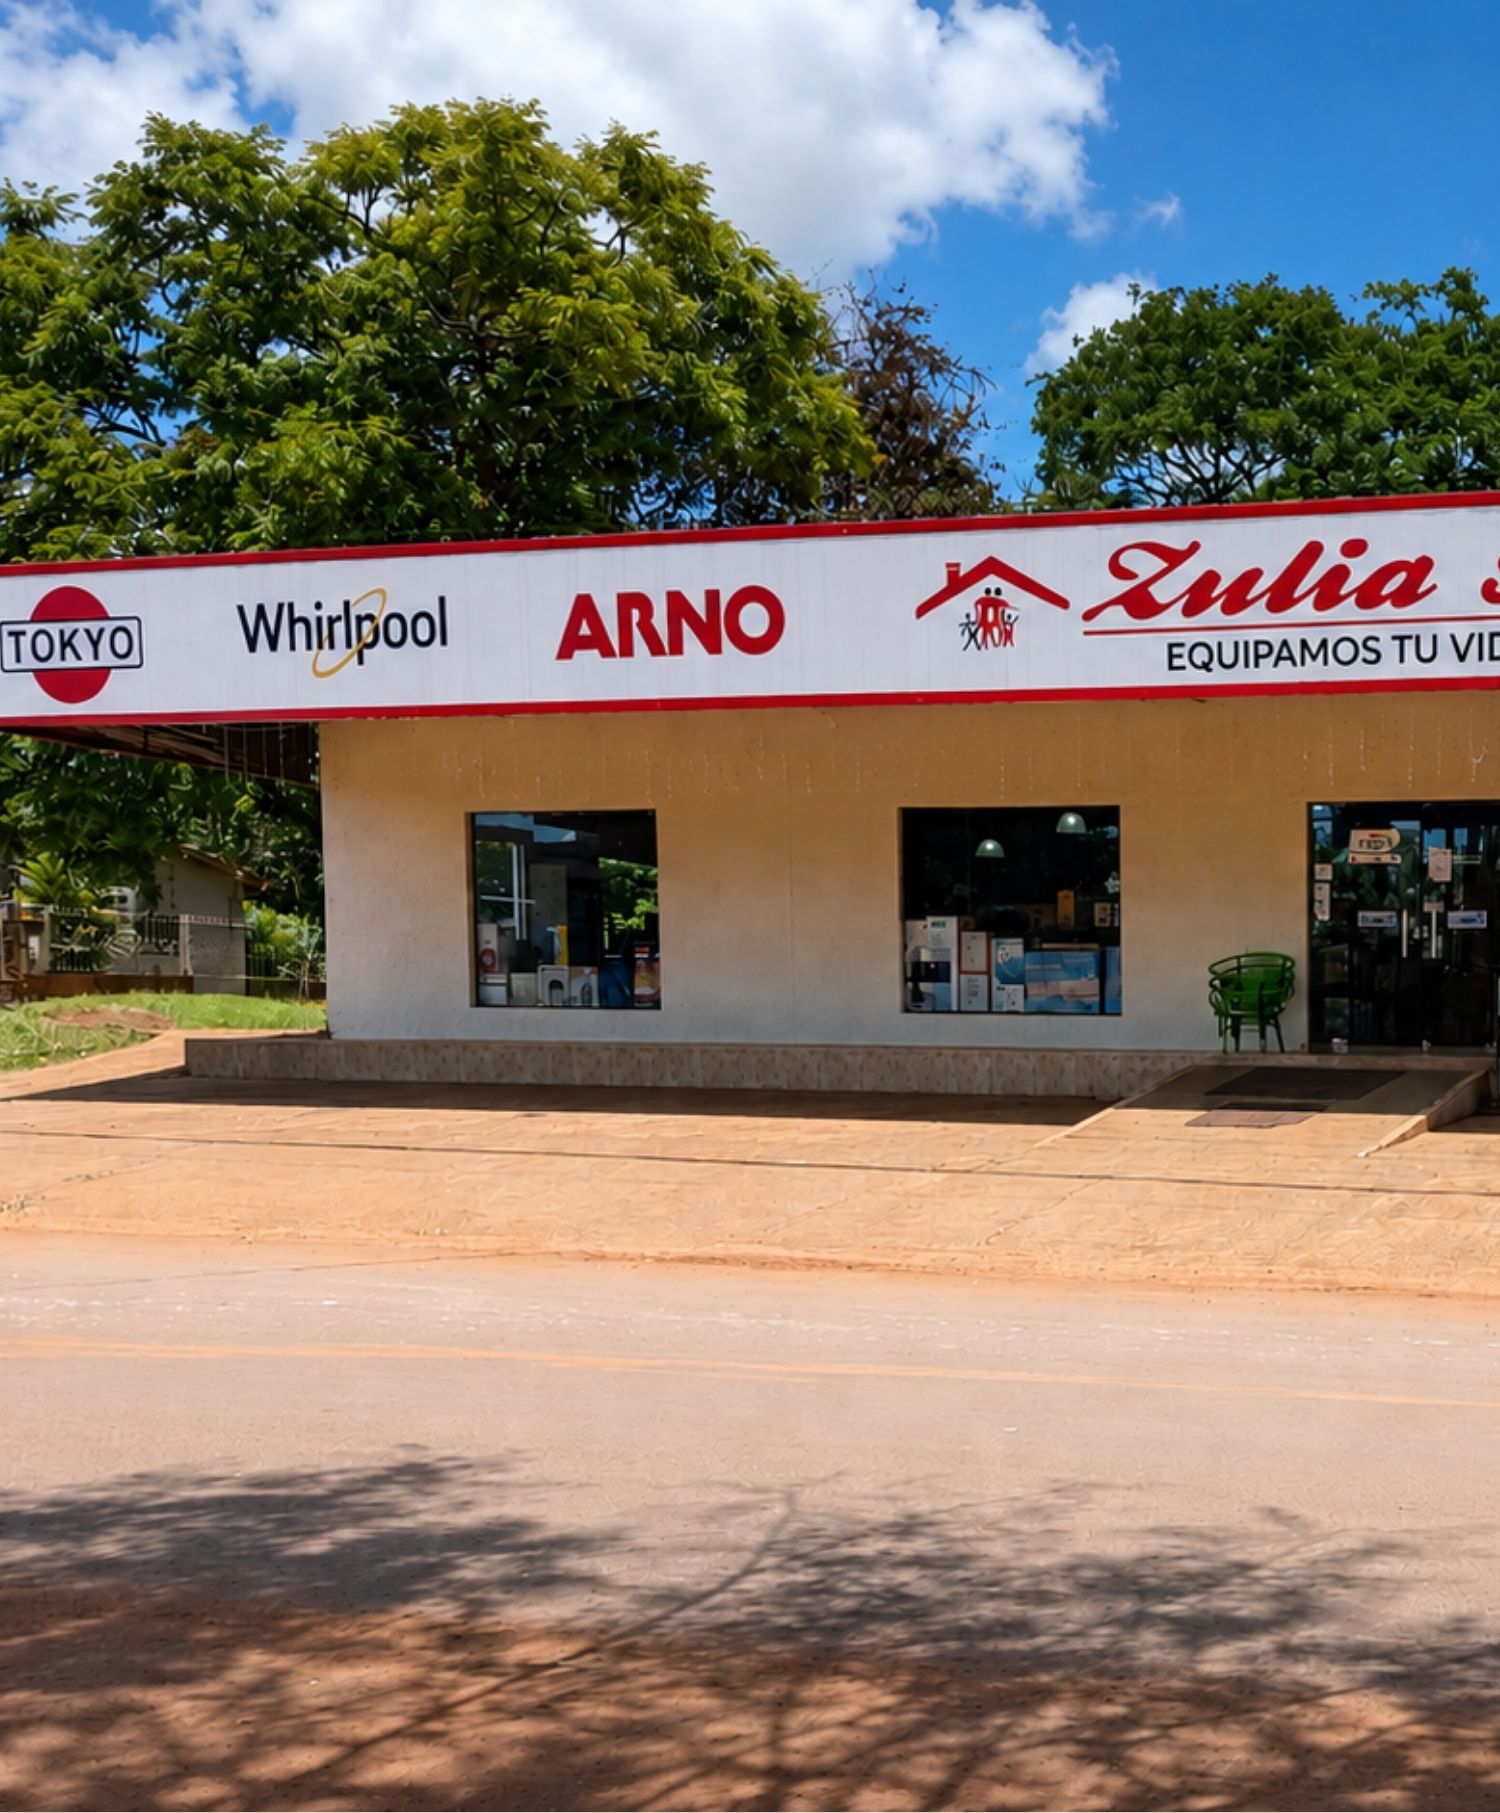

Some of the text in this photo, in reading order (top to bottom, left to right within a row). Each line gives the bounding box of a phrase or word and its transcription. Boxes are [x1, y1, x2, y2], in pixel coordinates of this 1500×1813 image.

[1081, 538, 1438, 623] Zulia
[7, 625, 134, 664] TOKYO
[236, 595, 448, 667] Whirlpool
[556, 584, 786, 661] ARNO
[1166, 634, 1384, 673] EQUIPAMOS
[1390, 632, 1438, 664] TU
